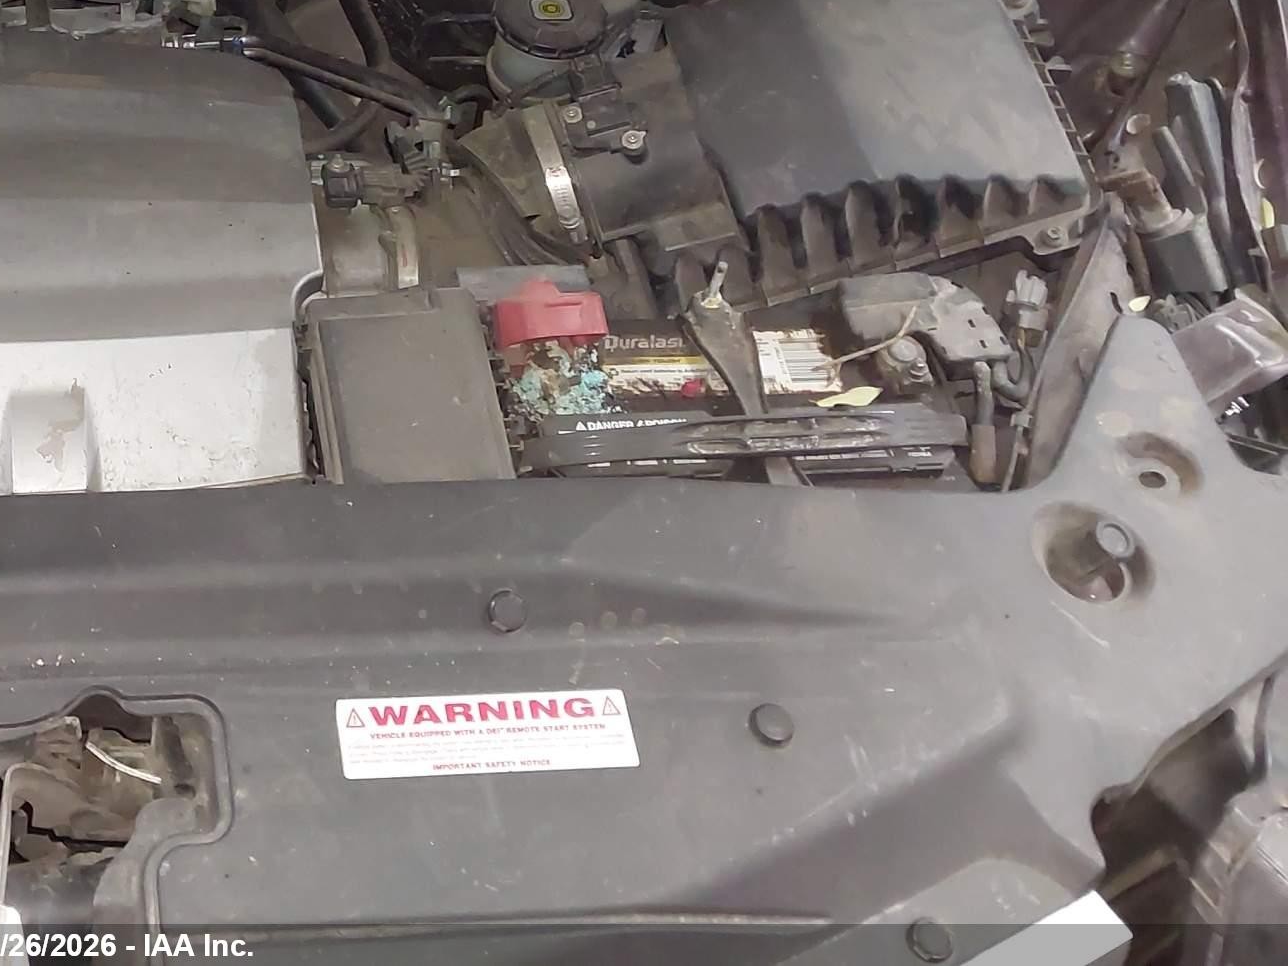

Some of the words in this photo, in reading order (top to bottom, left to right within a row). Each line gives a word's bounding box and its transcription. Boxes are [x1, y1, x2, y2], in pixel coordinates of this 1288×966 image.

[368, 698, 595, 726] WARNING
[370, 731, 406, 739] VEHICLE
[409, 730, 451, 738] EQUIPPED
[573, 723, 606, 731] SYSTEM
[433, 762, 481, 771] IMPORTANT
